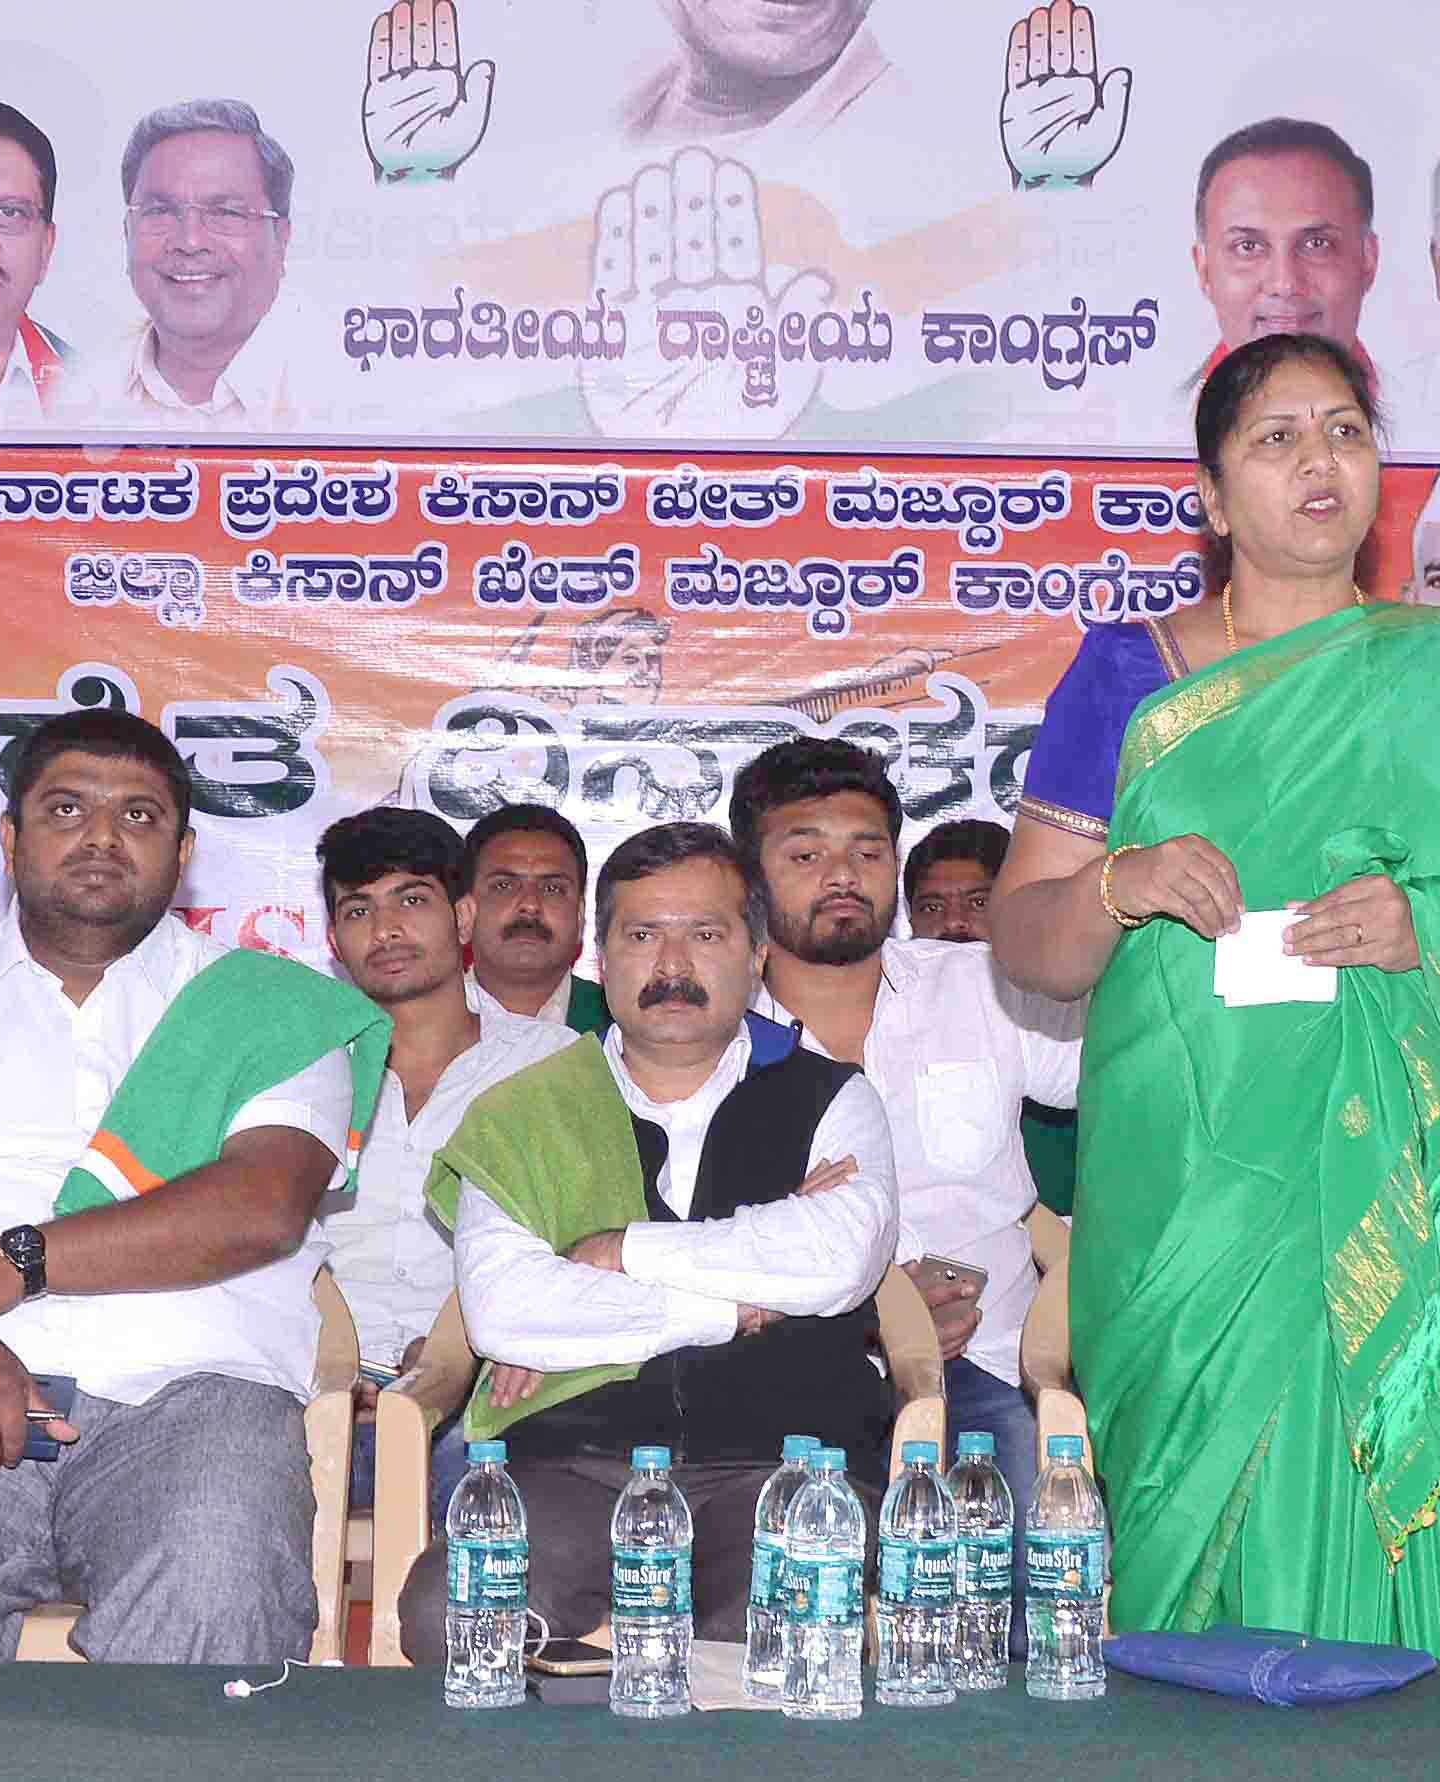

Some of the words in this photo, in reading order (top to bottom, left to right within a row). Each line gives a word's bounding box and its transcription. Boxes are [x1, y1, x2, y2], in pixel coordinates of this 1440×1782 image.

[344, 288, 627, 371] ಭಾರತೀಯ
[655, 291, 893, 408] ರಾಷ್ಟ್ರೀಯ
[921, 296, 1159, 391] ಕಾಂಗ್ರೆಸ್
[225, 464, 393, 534] ಪ್ರದೇಶ
[425, 470, 620, 520] ಕಿಸಾನ್
[652, 472, 800, 522] ಖೇತ್
[69, 556, 200, 624] ಜಿಲ್ಲಾ
[236, 546, 442, 604] ಕಿಸಾನ್
[478, 545, 636, 604] ಖೇತ್
[955, 555, 1201, 624] ಕಾಂಗ್ರೆಸ್
